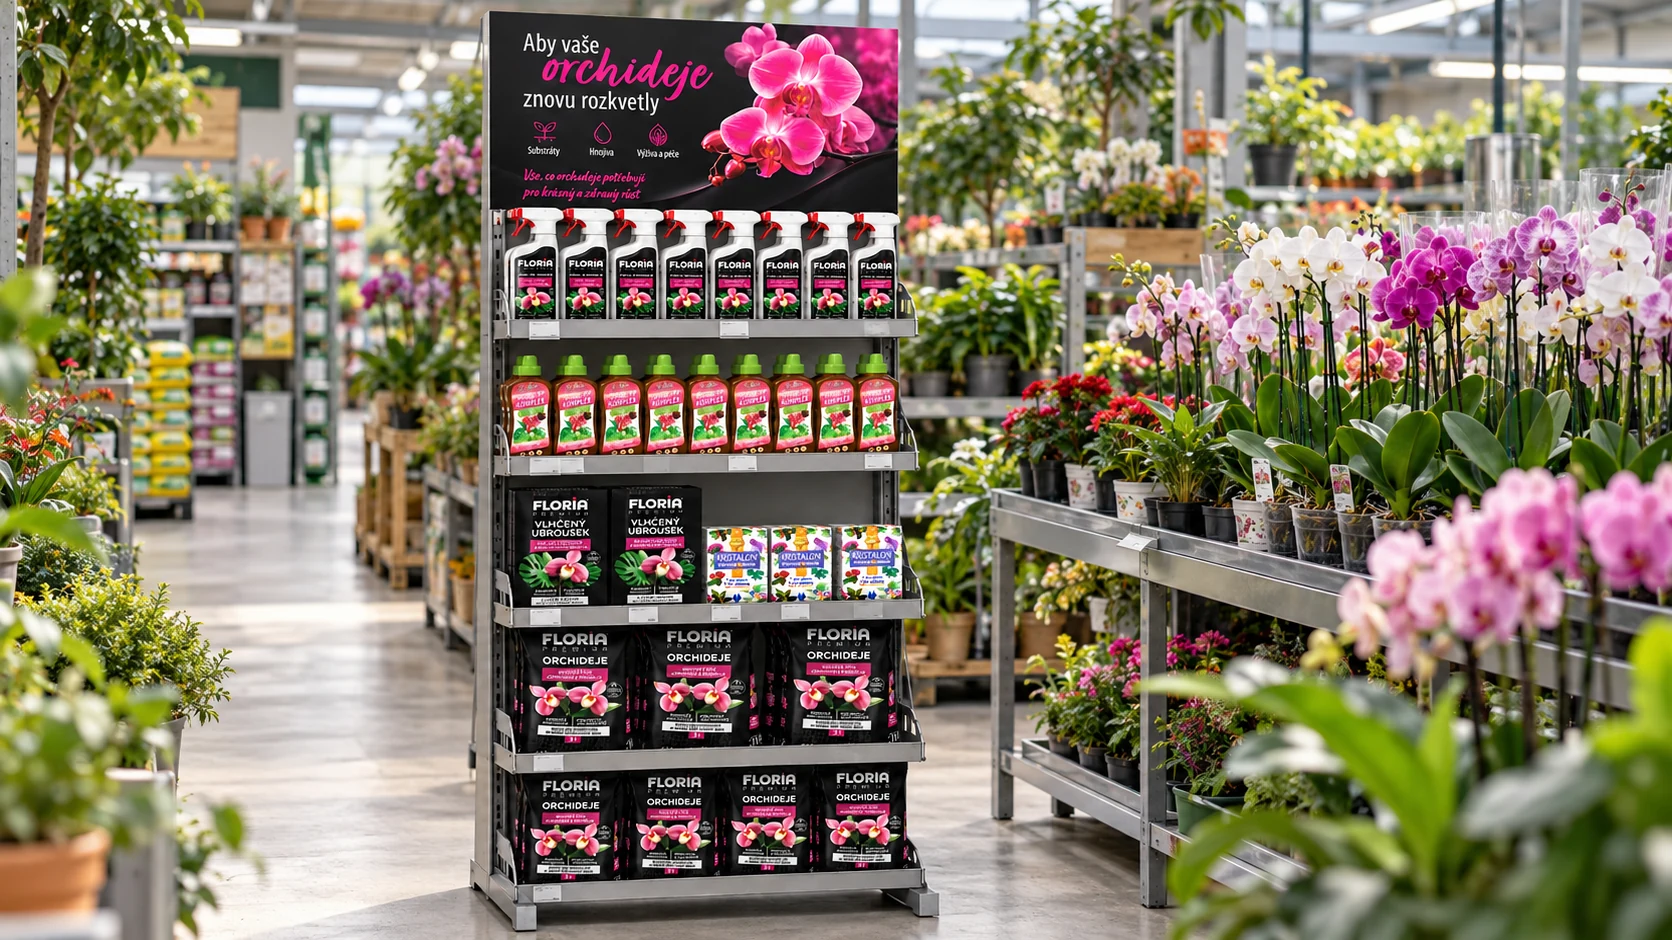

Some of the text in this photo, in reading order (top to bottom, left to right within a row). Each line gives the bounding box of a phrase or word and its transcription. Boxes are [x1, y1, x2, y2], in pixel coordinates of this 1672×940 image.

[523, 33, 600, 57] Aby vaše
[542, 47, 714, 101] orchideje
[523, 90, 659, 116] znovu rozkvetly
[528, 146, 560, 157] Substráty
[590, 147, 614, 158] Hnojiva
[637, 148, 658, 158] Výživa
[664, 150, 680, 159] péče
[556, 170, 601, 186] orchideje
[522, 188, 540, 200] pro
[541, 185, 575, 202] krásný
[576, 190, 582, 198] a
[532, 529, 589, 537] UBROUSEK
[628, 527, 684, 535] UBROUSEK
[667, 653, 731, 662] ORCHIDEJE
[807, 651, 870, 660] ORCHIDEJE
[542, 656, 608, 665] ORCHIDEJE
[742, 795, 796, 803] ORCHIDEJE
[836, 793, 890, 801] ORCHIDEJE
[542, 801, 600, 810] ORCHIDEJE
[647, 798, 701, 806] ORCHIDEJE
